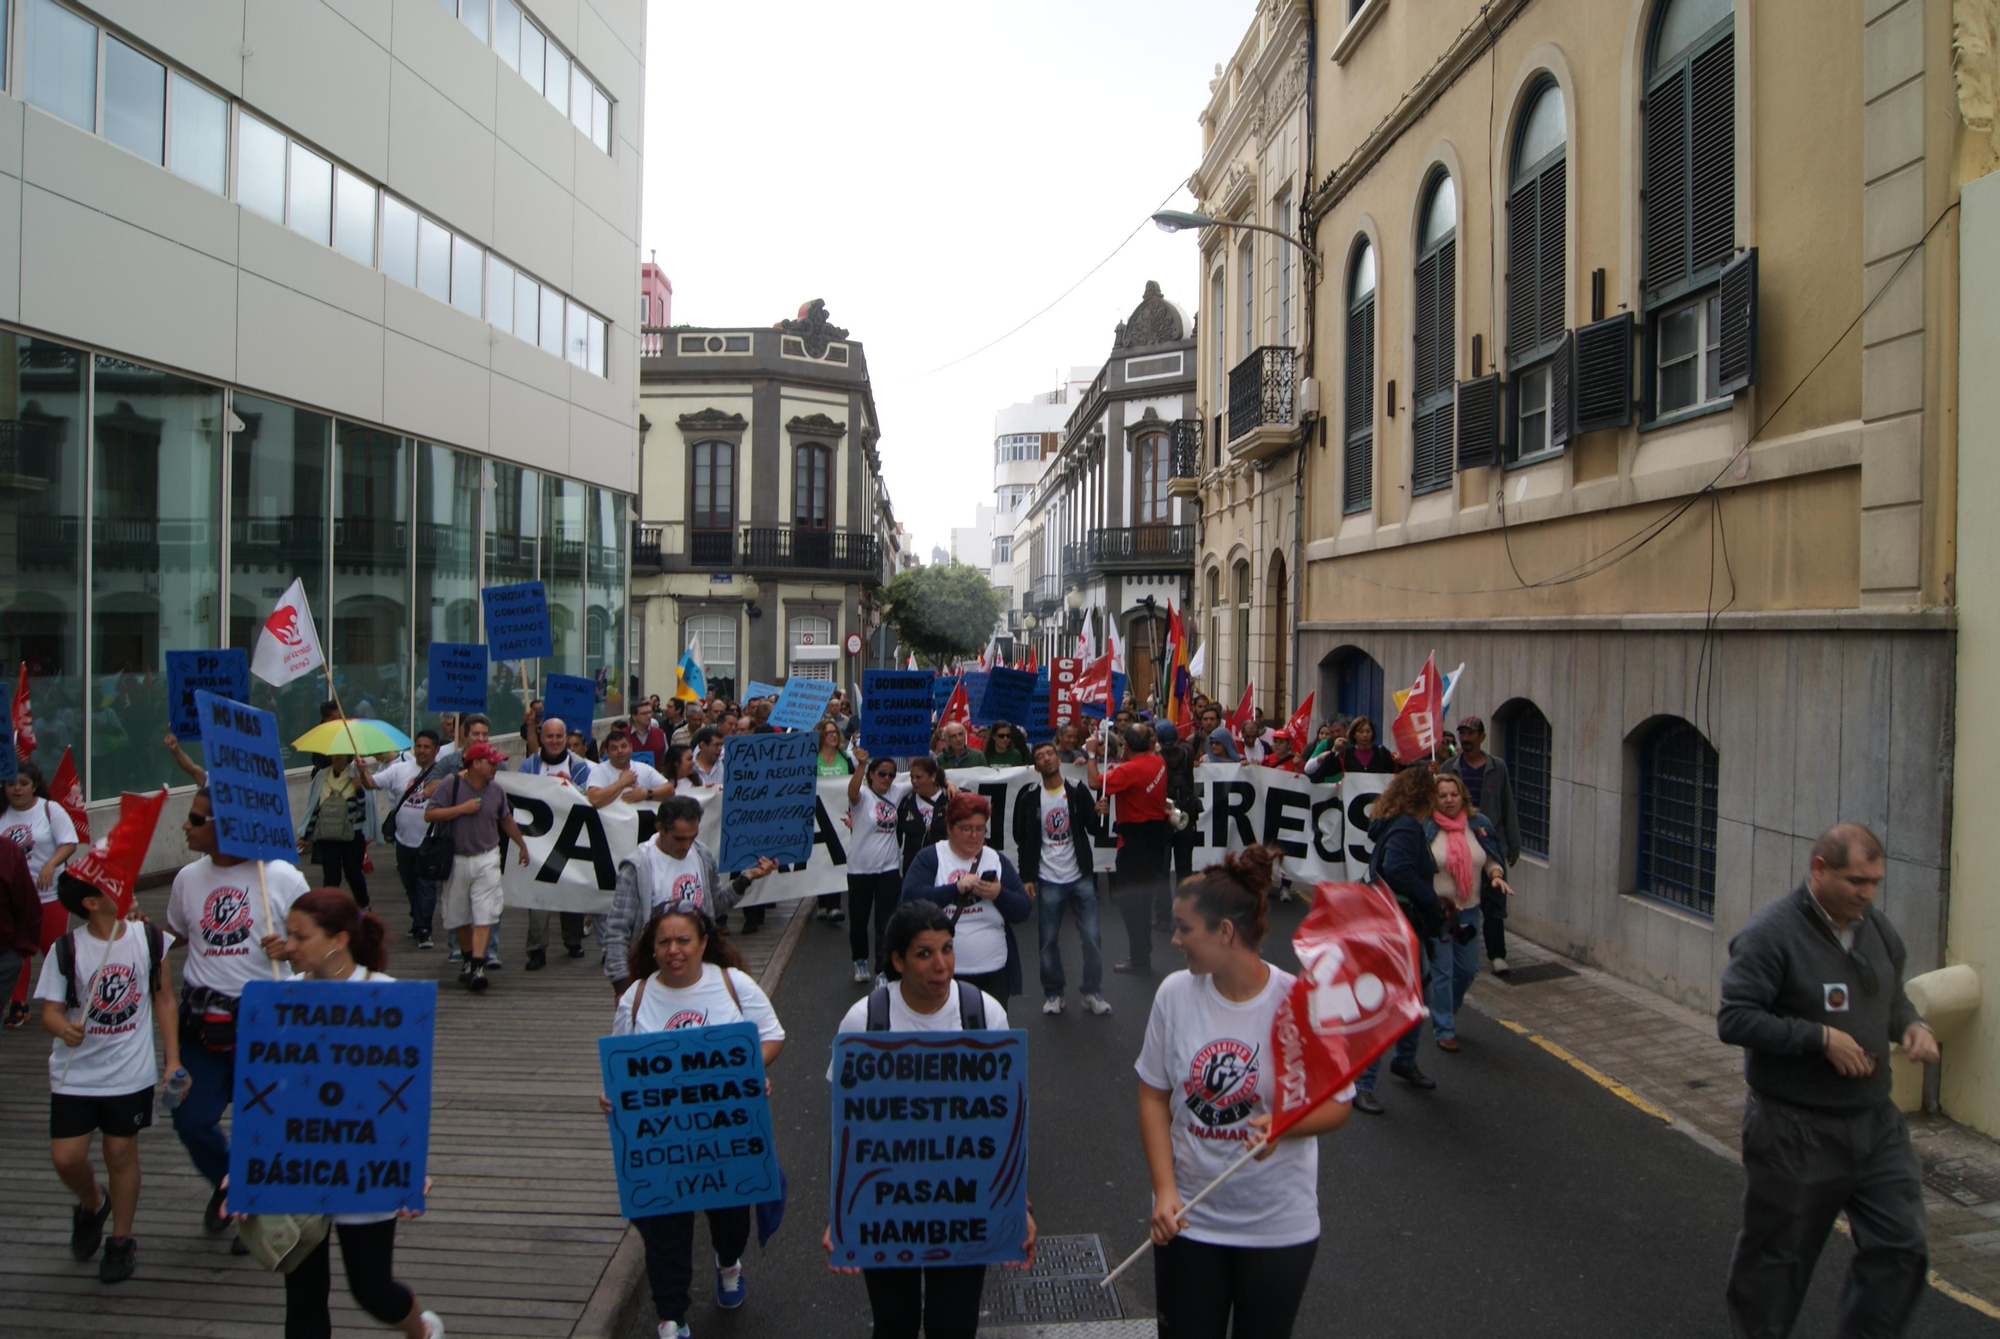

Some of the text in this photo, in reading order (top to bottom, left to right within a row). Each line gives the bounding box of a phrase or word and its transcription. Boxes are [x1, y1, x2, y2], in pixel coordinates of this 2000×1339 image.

[488, 588, 527, 603] PORQUE
[494, 602, 542, 618] COMEMOS
[493, 621, 545, 636] ESTAMOS
[452, 649, 471, 658] PAN
[499, 636, 544, 651] HARTOS
[197, 657, 218, 674] PP
[440, 660, 483, 671] TRABAJO
[446, 672, 477, 682] TECHO
[436, 696, 484, 707] DERECHOS
[553, 682, 589, 695] CARIDAD
[867, 698, 881, 711] DE
[883, 697, 933, 711] CANARIAS
[212, 701, 232, 728] NO
[234, 708, 262, 739] MAS
[875, 712, 924, 727] GOBIERNO
[866, 733, 930, 746] DE CANALLAS
[209, 741, 280, 781] LAMENTOS
[232, 784, 284, 816] TIEMPO
[727, 784, 769, 802] AGUA
[239, 818, 292, 850] LUCHAR
[273, 1003, 404, 1029] TRABAJO
[248, 1041, 421, 1068] PARA TODAS
[627, 1046, 748, 1078] NO MAS
[839, 1051, 1013, 1090] ¿GOBIERNO?
[317, 1081, 345, 1107] O
[620, 1078, 762, 1111] ESPERAS
[843, 1094, 1009, 1122] NUESTRAS
[284, 1118, 377, 1145] RENTA
[636, 1108, 749, 1139] AYUDAS
[630, 1136, 765, 1169] SOCIALES
[855, 1135, 996, 1164] FAMILIAS
[245, 1151, 412, 1193] BÁSICA ¡YA!
[674, 1170, 728, 1199] ¡YA!
[874, 1176, 979, 1206] PASAN
[859, 1218, 988, 1246] HAMBRE
